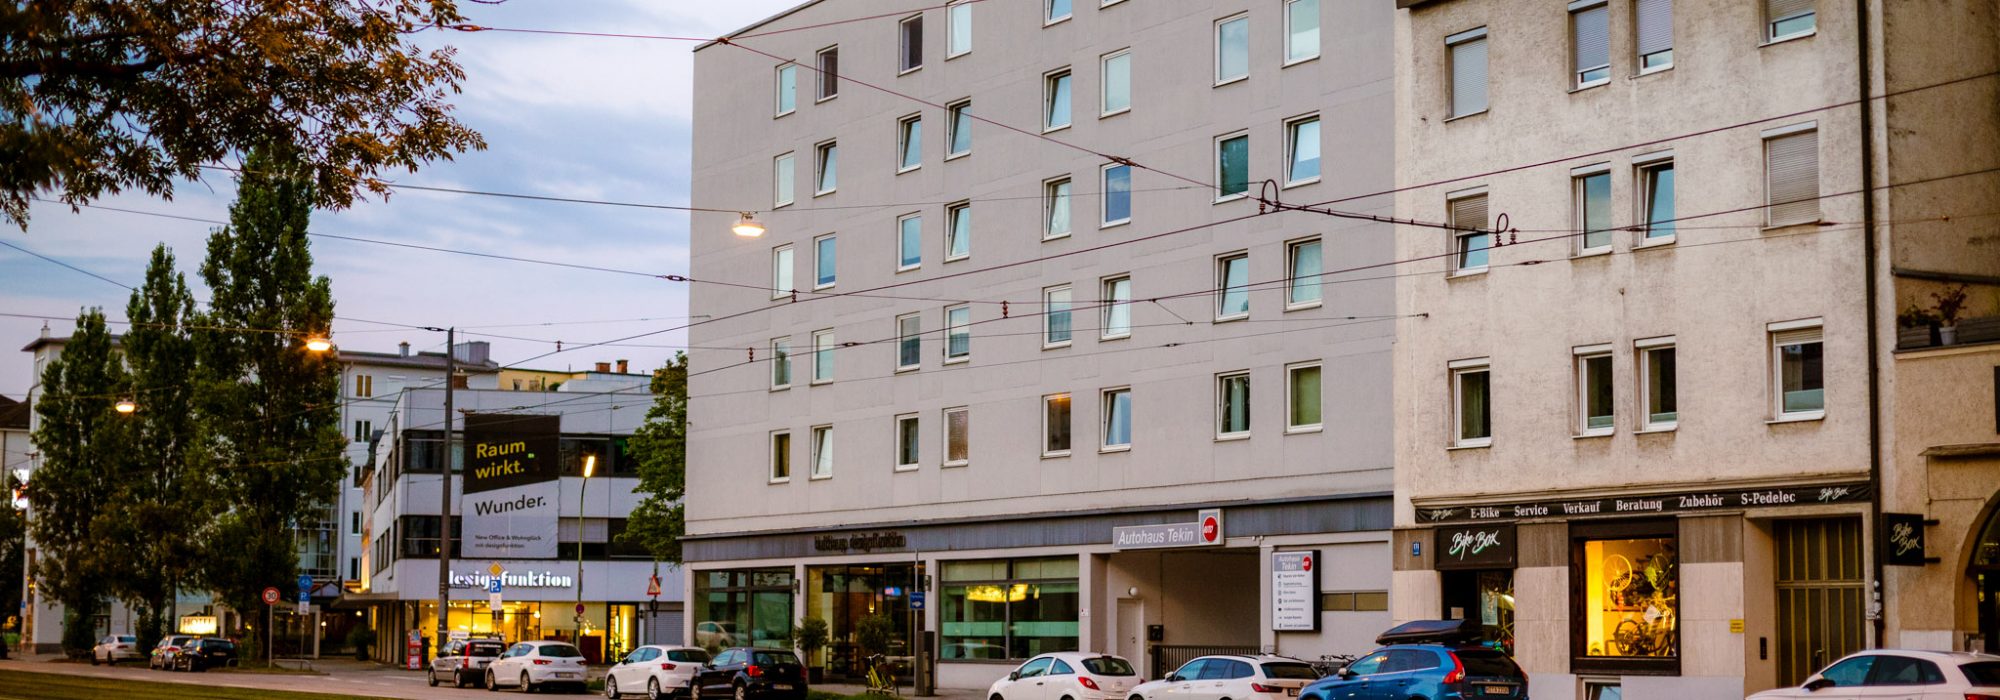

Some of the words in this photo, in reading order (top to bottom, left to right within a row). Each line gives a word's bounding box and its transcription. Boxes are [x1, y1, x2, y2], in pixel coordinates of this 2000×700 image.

[476, 441, 526, 459] Raum
[475, 459, 525, 479] wirkt.
[474, 494, 547, 517] Wunder.
[1470, 507, 1500, 519] E-Bike
[1514, 505, 1549, 517] Service
[1563, 501, 1601, 514] Verkauf
[1616, 499, 1663, 511] Beratung
[1679, 494, 1725, 508] Zubehör
[1741, 490, 1796, 505] S-Pedelec
[1118, 530, 1165, 545] Autohaus
[1167, 527, 1194, 541] Tekin
[1890, 522, 1913, 543] Bike
[1448, 530, 1475, 561] Bike
[1471, 530, 1501, 554] Box
[1896, 536, 1922, 556] Box
[448, 570, 572, 591] esigfunktion
[267, 591, 278, 600] 30
